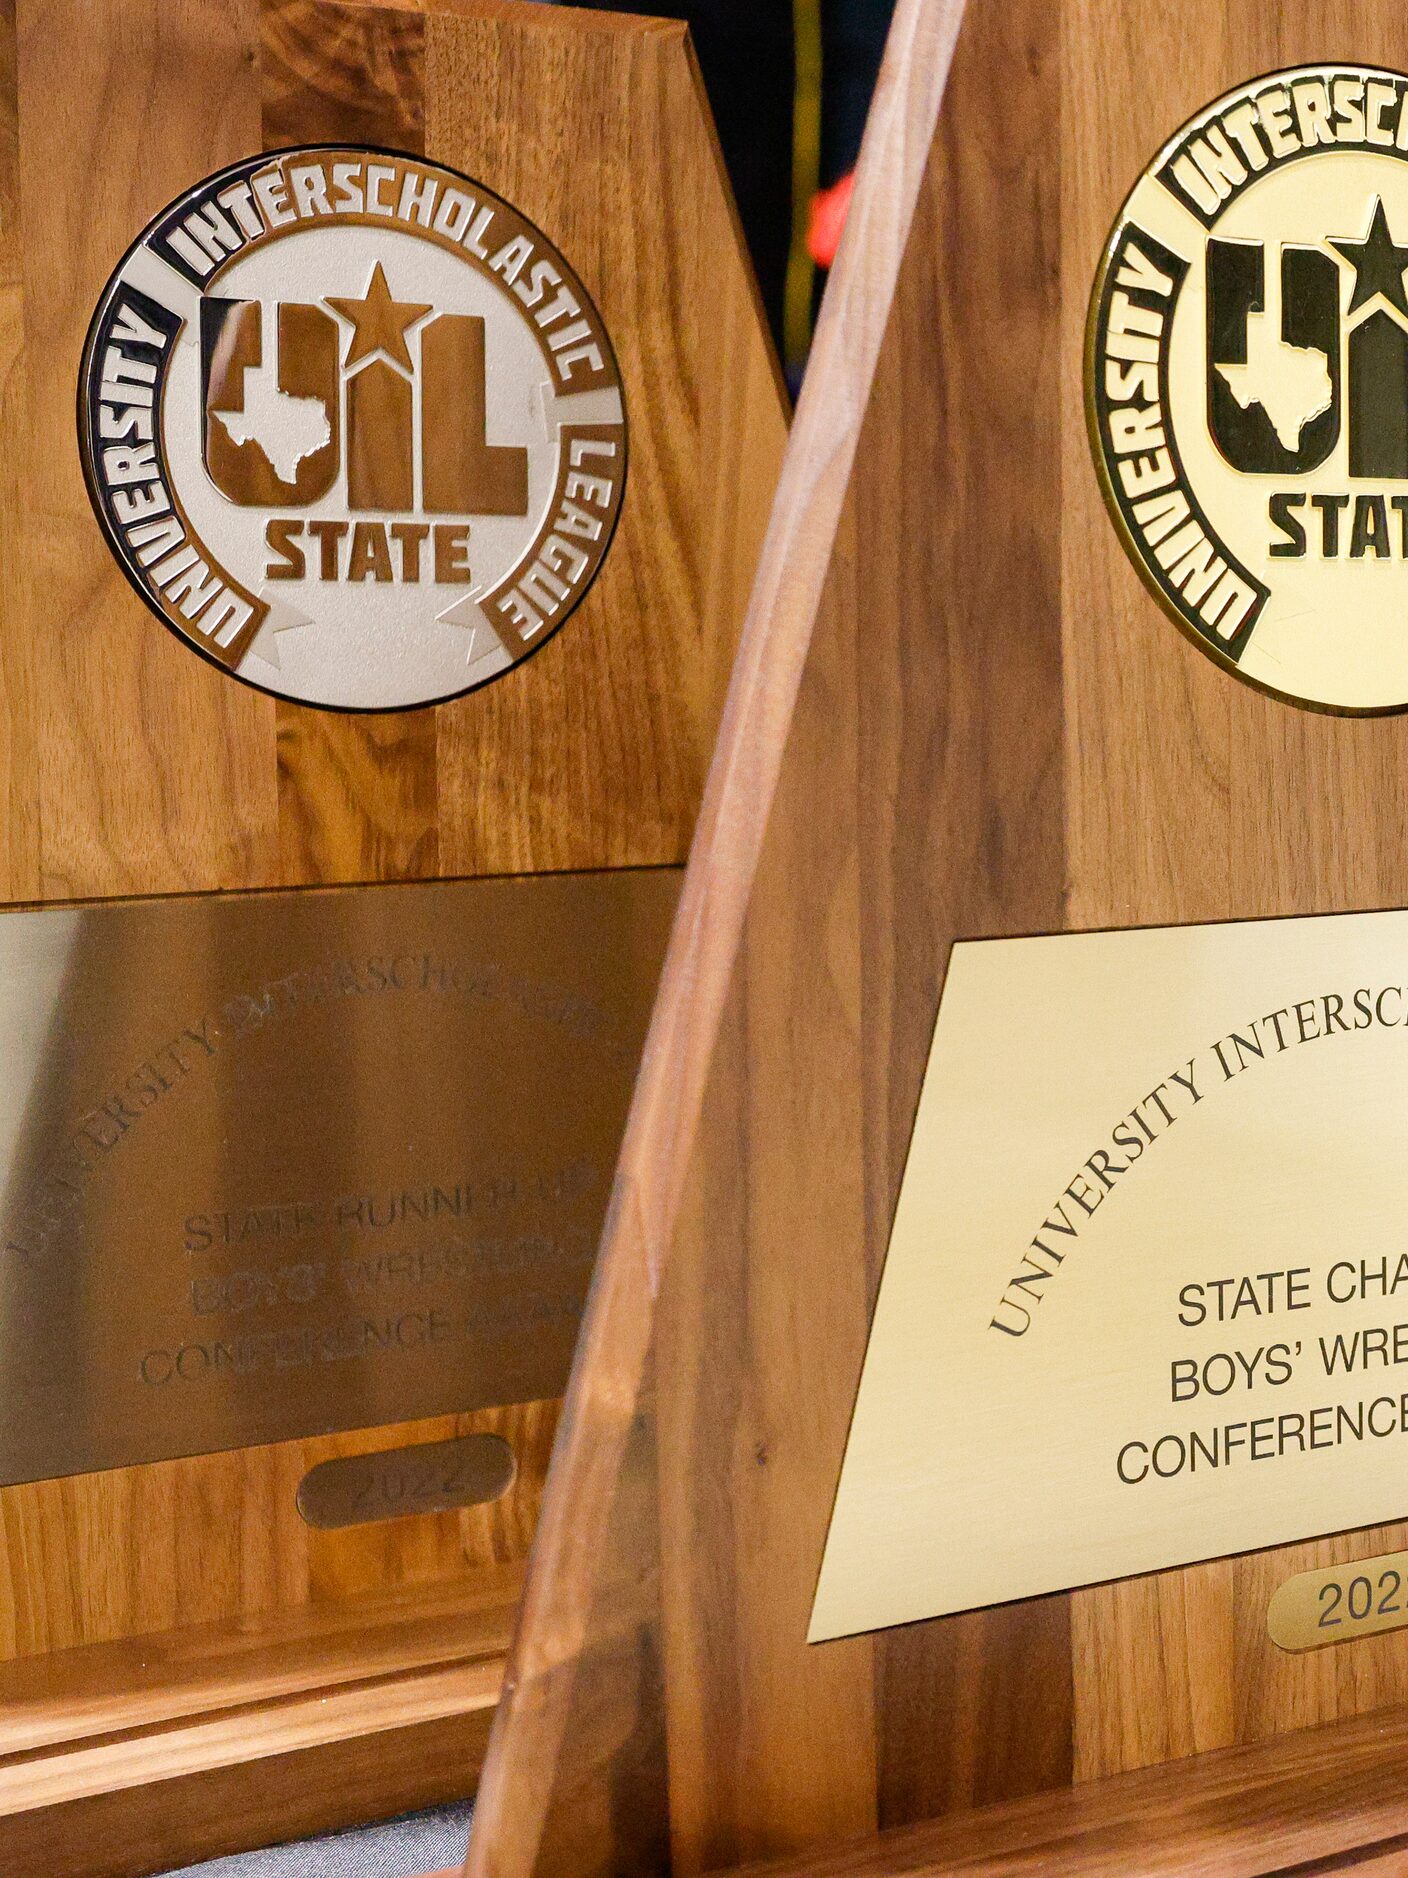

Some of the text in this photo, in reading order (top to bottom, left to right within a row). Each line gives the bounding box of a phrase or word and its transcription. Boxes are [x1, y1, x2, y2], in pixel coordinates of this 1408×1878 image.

[99, 161, 617, 650] UNIVERSITY INTERSCHOLASTIC LEAGUE
[1104, 240, 1259, 641] UNIVERSITY
[264, 519, 471, 584] STATE
[988, 1058, 1206, 1340] UNIVERSITY
[1178, 1267, 1312, 1327] STATE
[1171, 1341, 1305, 1403] BOYS'
[351, 1455, 466, 1515] 2022
